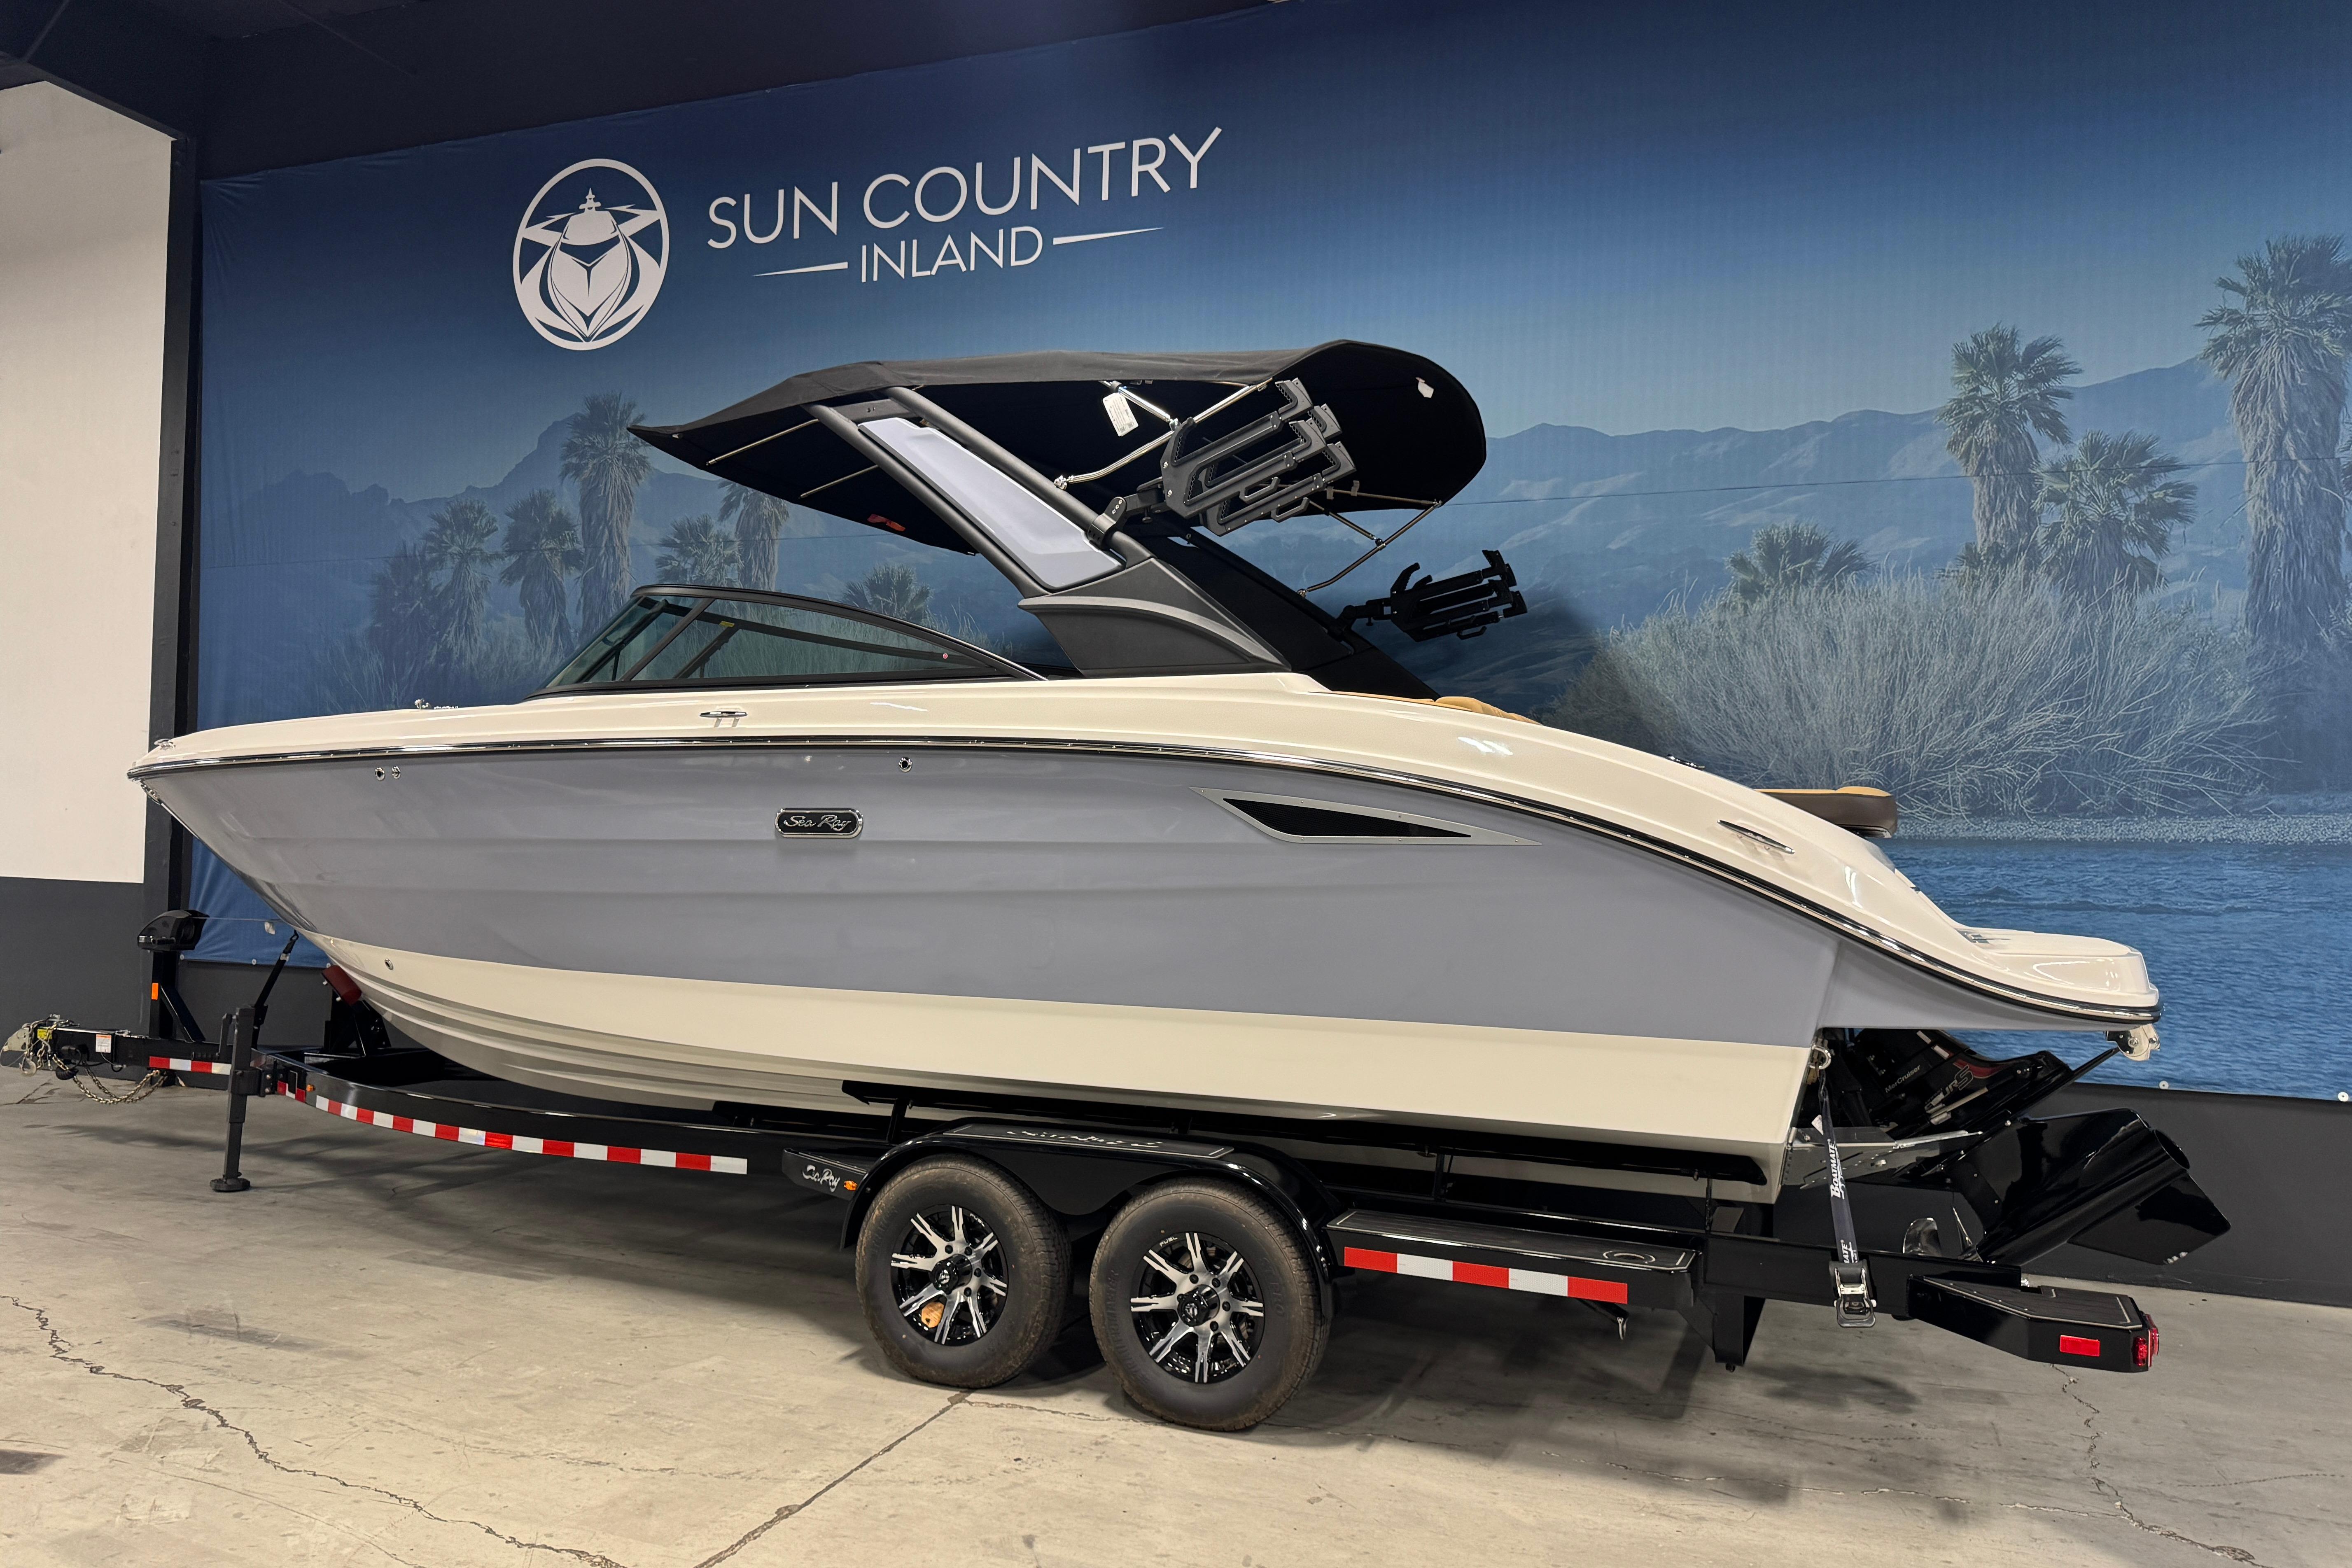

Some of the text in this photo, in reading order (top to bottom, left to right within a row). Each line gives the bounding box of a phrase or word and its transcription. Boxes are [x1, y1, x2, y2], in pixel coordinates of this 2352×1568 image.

[707, 126, 1223, 249] SUN COUNTRY
[861, 226, 1043, 283] INLAND
[783, 814, 852, 832] Sea Ray
[1885, 1065, 1920, 1093] MerCruiser
[969, 1213, 985, 1227] FUEL
[1159, 1236, 1178, 1247] FUEL
